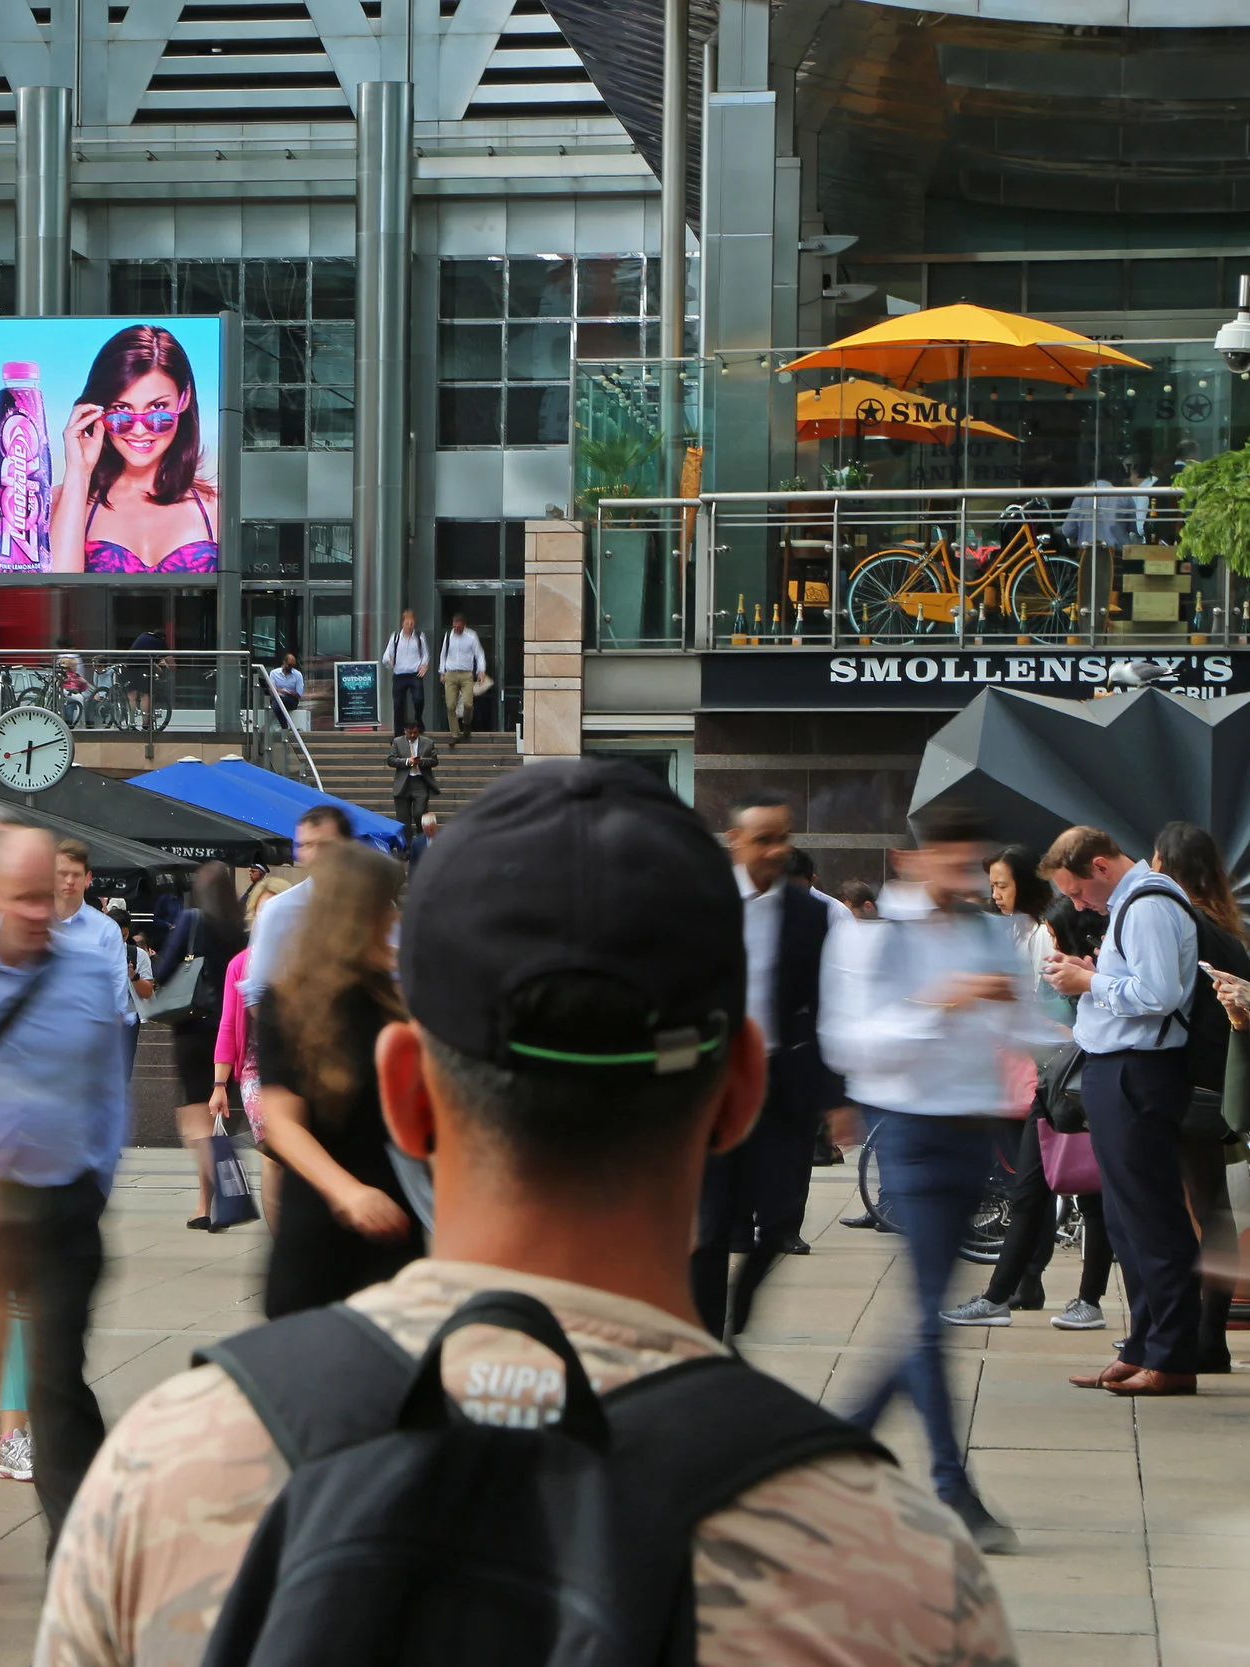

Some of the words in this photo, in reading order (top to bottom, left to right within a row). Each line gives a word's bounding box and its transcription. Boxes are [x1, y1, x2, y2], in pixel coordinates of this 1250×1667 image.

[11, 443, 27, 541] Lucozade
[830, 655, 1233, 683] SMOLLENSY'S
[15, 763, 22, 773] 7
